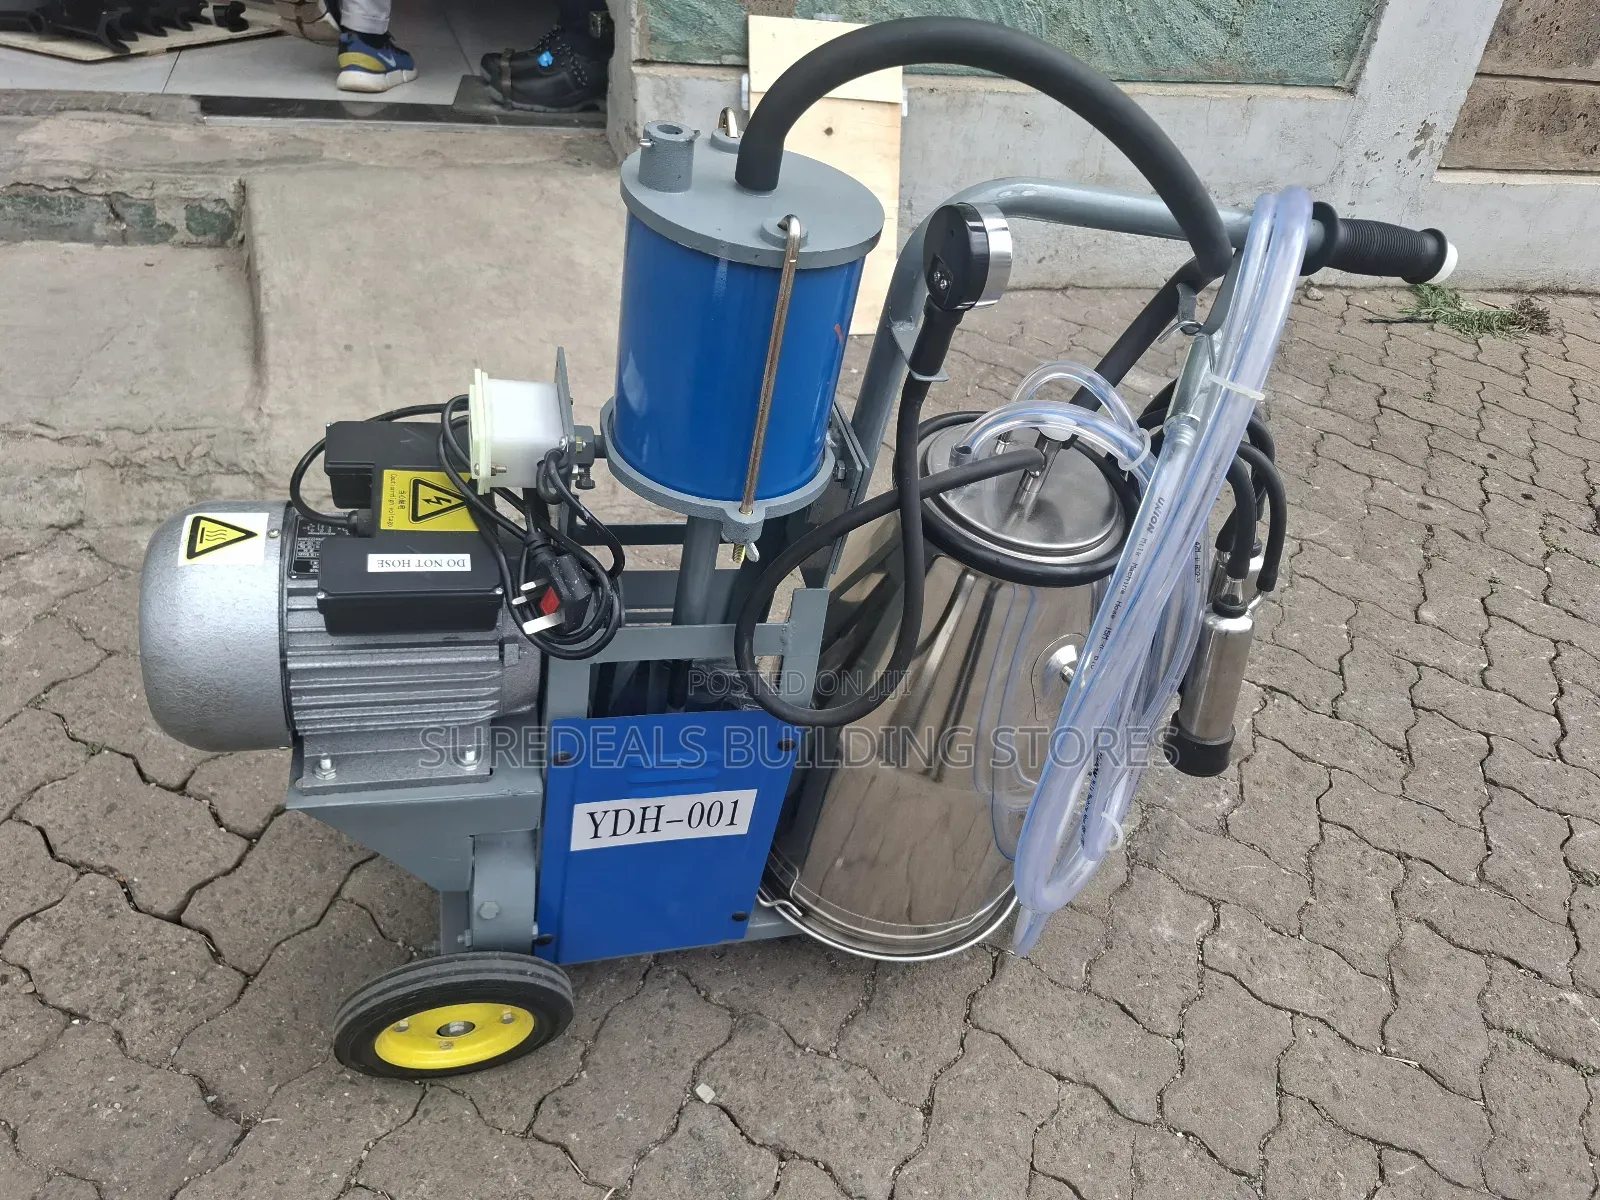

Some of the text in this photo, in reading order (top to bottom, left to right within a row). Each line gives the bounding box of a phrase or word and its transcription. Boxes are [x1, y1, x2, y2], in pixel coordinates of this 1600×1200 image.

[1147, 497, 1165, 534] UNION
[377, 559, 466, 568] DO NOT HOSE
[586, 798, 740, 840] YDH-001
